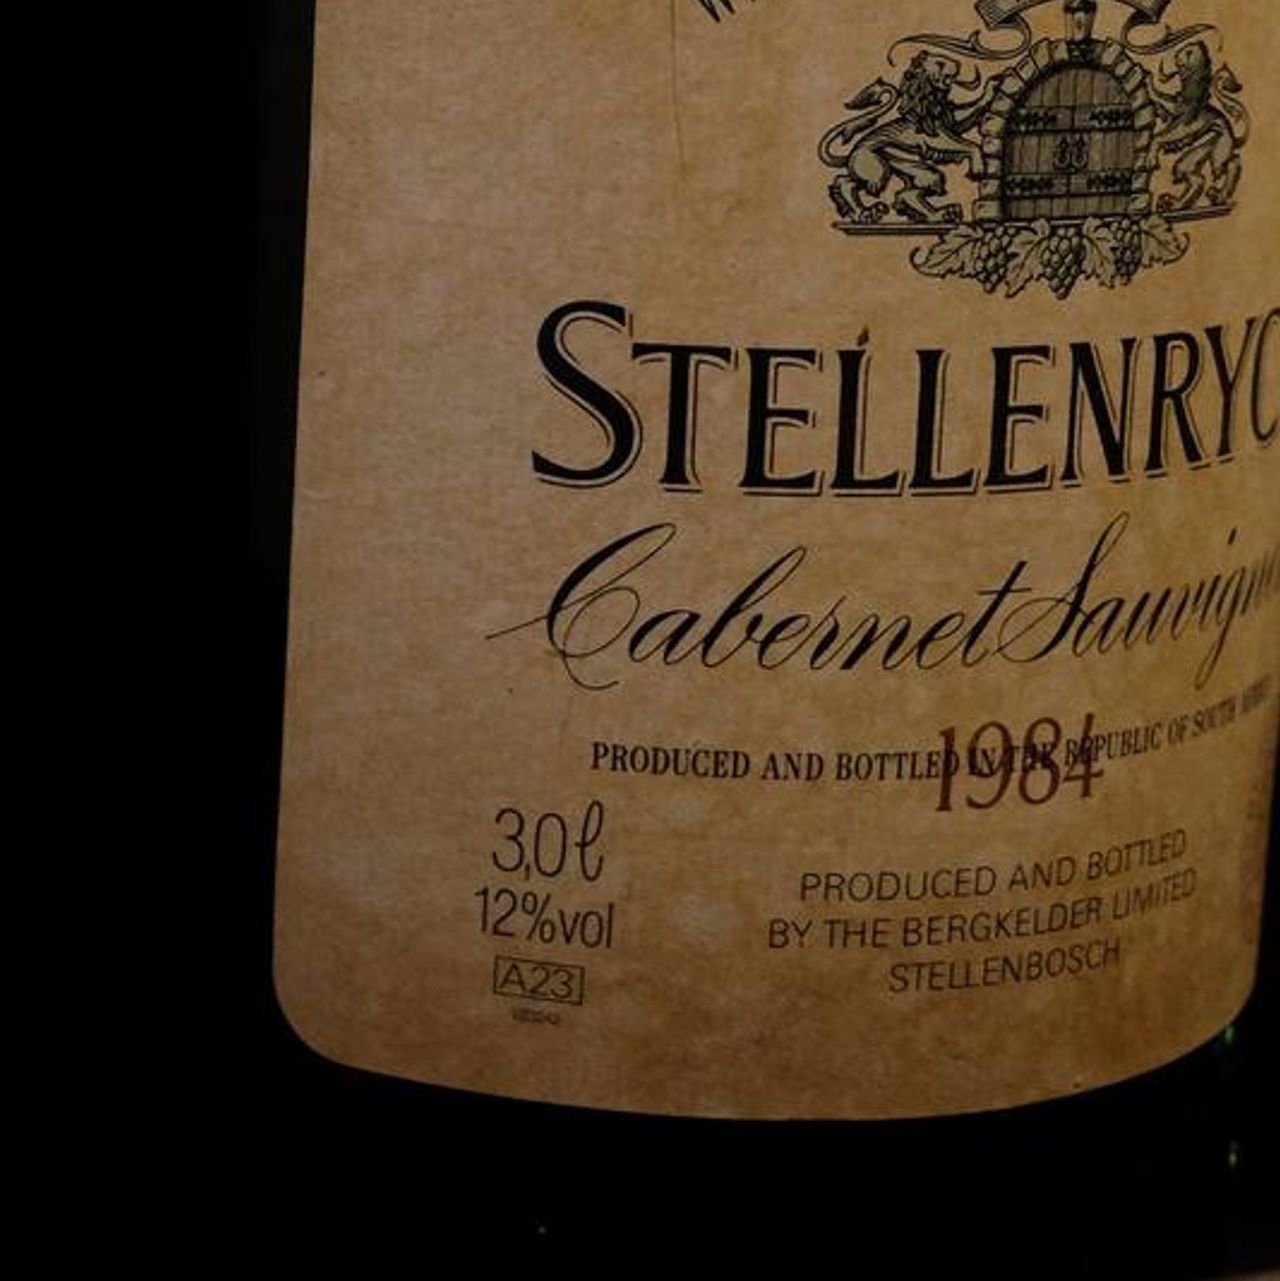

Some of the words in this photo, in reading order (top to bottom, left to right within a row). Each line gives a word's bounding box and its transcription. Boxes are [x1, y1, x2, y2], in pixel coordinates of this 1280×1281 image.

[486, 522, 1029, 690] Cabernet
[590, 740, 752, 781] PRODUCED
[760, 750, 825, 782] AND
[835, 749, 961, 783] BOTTLED
[935, 710, 1106, 813] 1984
[799, 865, 998, 904] PRODUCED
[1007, 854, 1078, 892] AND
[1086, 827, 1188, 882] BOTTLED
[768, 919, 820, 950] BY
[826, 917, 896, 951] THE
[903, 893, 1103, 948] BERGKELDER
[1111, 867, 1198, 921] LIMITED
[499, 961, 577, 999] A23
[887, 936, 1122, 995] STELLENBOSCH
